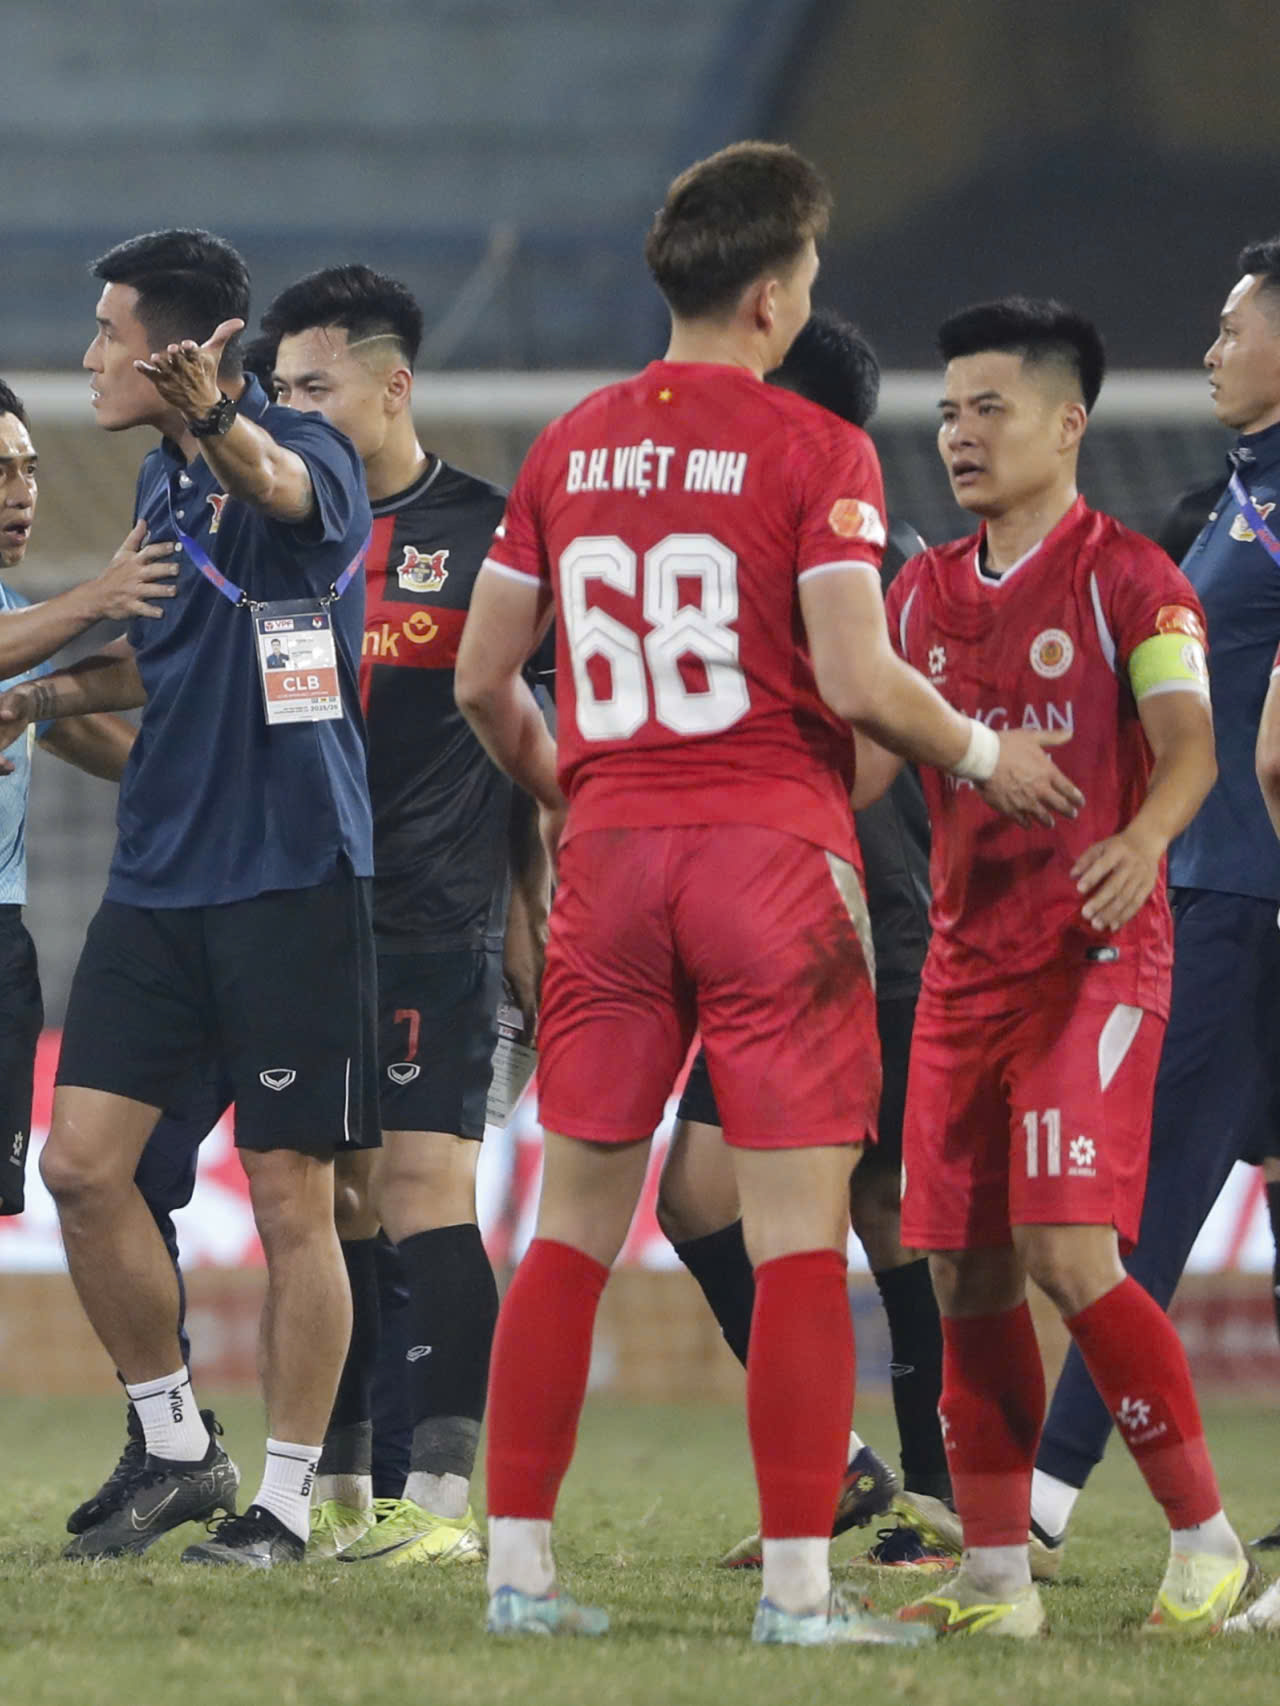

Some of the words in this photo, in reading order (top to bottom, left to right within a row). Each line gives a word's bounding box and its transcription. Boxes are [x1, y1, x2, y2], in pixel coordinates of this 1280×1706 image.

[566, 438, 675, 497] B.H.VIỆT
[684, 448, 748, 496] ANH
[558, 533, 751, 742] 68
[282, 674, 320, 692] CLB
[393, 1008, 421, 1062] 7
[1022, 1108, 1061, 1178] 11
[168, 1384, 184, 1424] Wika
